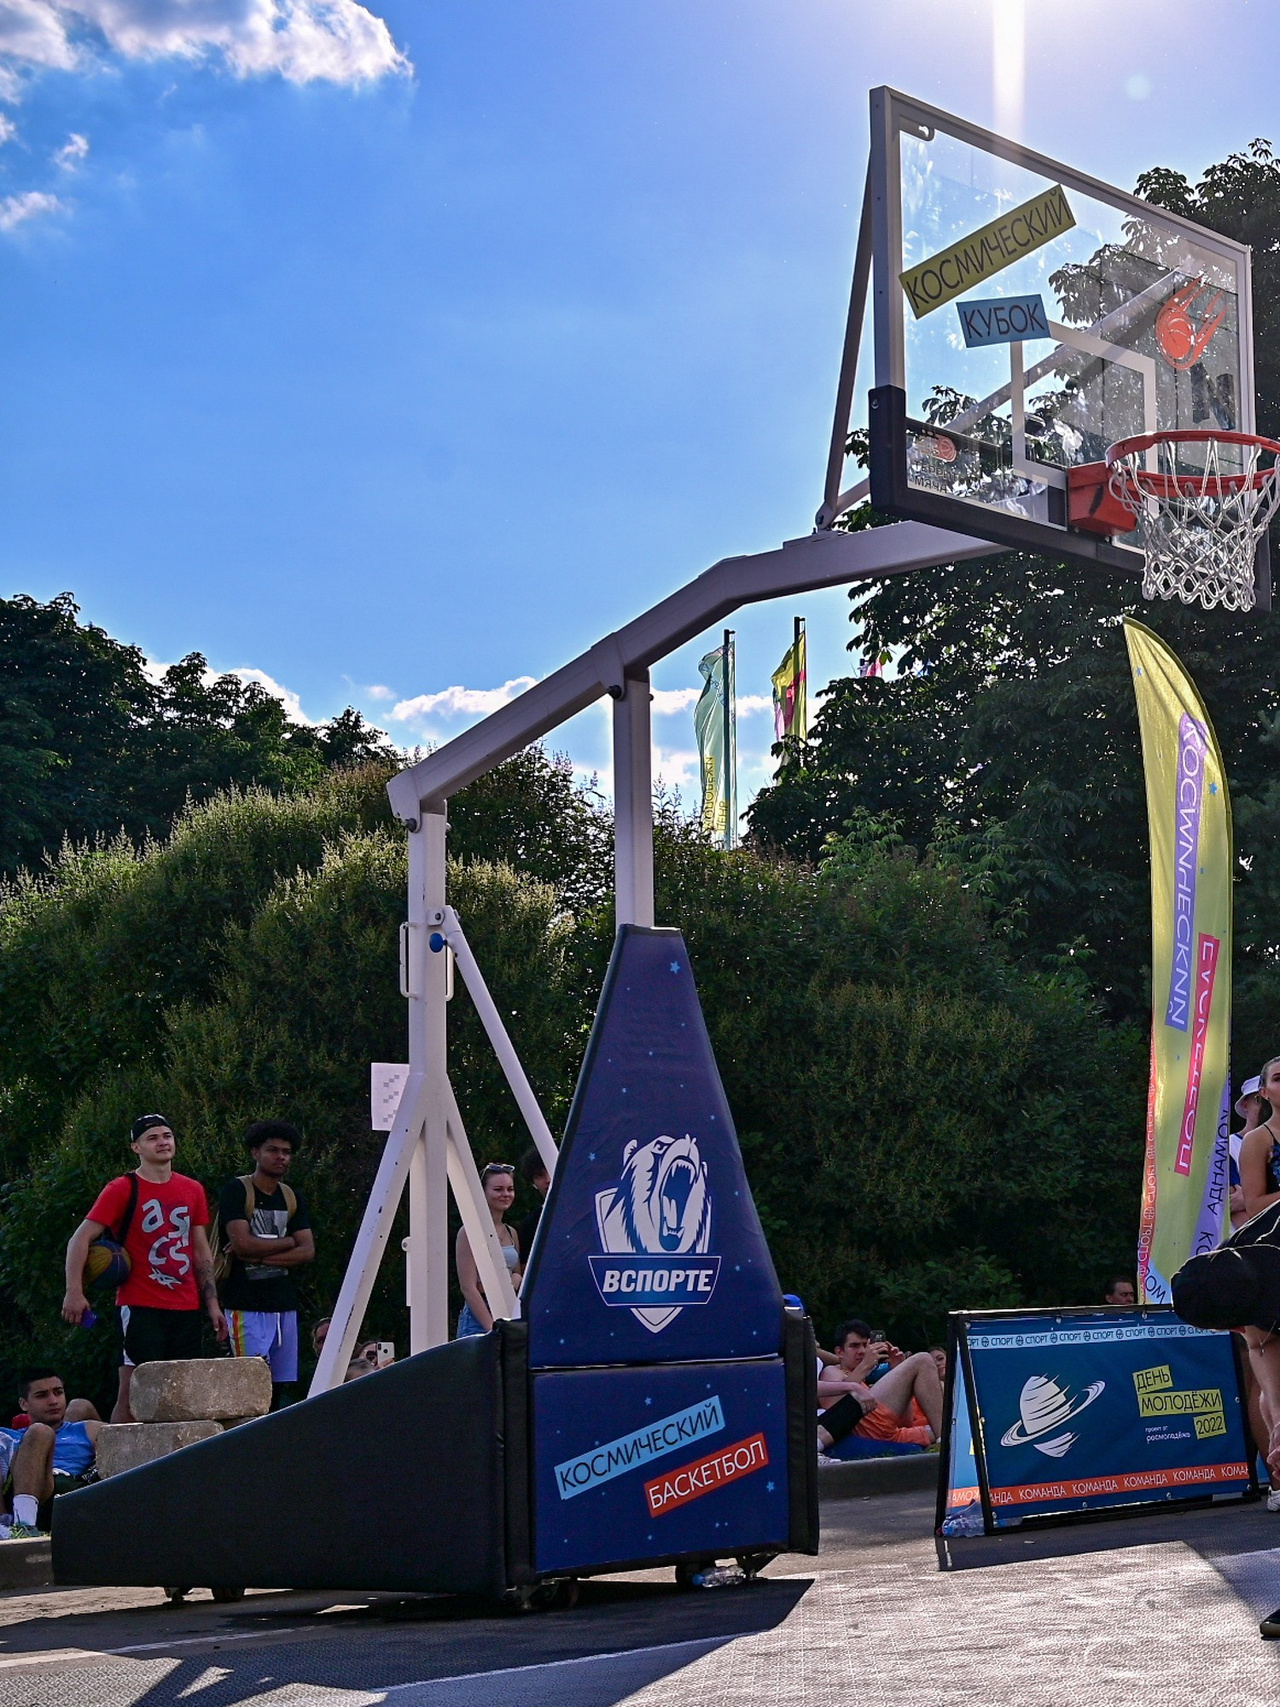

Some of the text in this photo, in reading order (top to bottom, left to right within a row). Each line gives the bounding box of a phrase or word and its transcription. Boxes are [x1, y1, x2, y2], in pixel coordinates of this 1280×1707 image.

[906, 192, 1073, 309] КОСМИЧЕСКИЙ
[962, 300, 1047, 340] КУБОК
[602, 1269, 713, 1293] ВСПОРТЕ
[1136, 1368, 1170, 1392] ДЕНЬ
[1141, 1391, 1221, 1413] МОЛОДЁЖИ
[1195, 1415, 1224, 1435] 2022
[559, 1403, 720, 1491] КОСМИЧЕСКИЙ
[648, 1438, 766, 1511] БАСКЕТБОЛ
[1019, 1484, 1067, 1501] КОМАНДА
[1071, 1479, 1118, 1496] КОМАНДА
[1122, 1474, 1169, 1491] КОМАНДА
[1172, 1468, 1217, 1483] КОМАНДА
